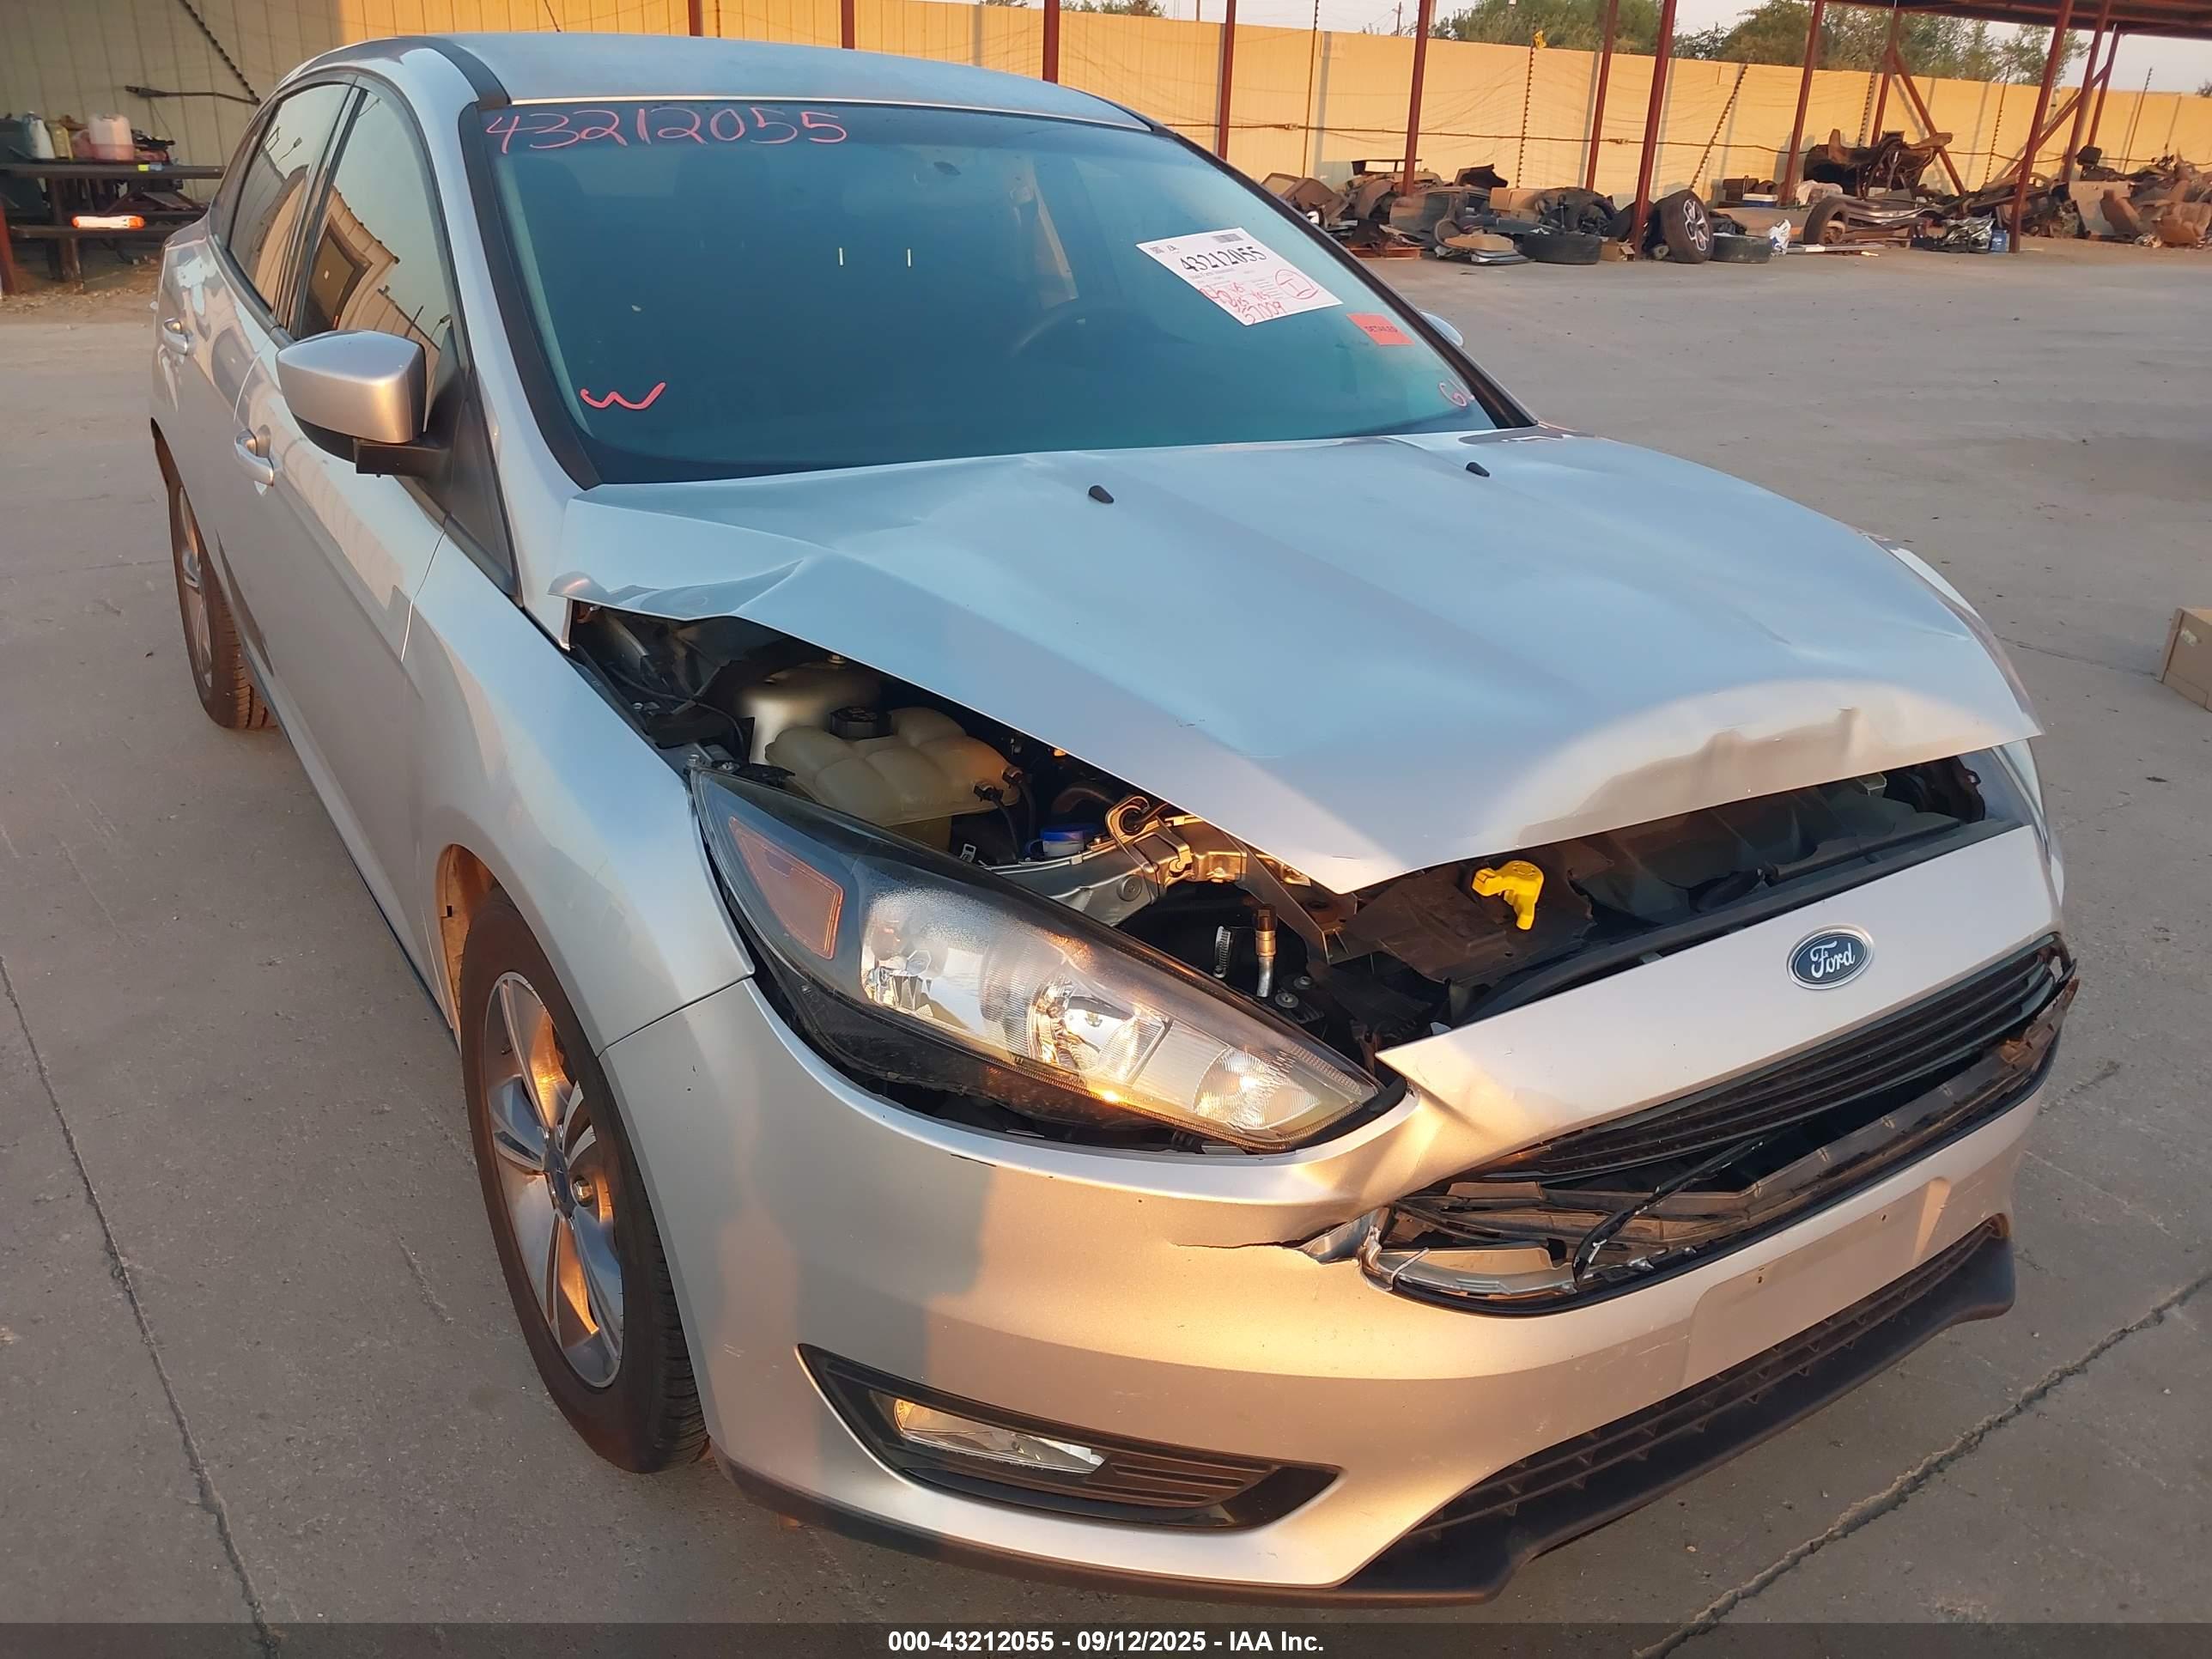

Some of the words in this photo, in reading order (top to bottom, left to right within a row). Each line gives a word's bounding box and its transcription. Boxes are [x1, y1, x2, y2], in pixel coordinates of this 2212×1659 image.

[485, 106, 848, 155] 43212055
[1180, 246, 1267, 273] 43212055
[1809, 940, 1856, 979] Ford
